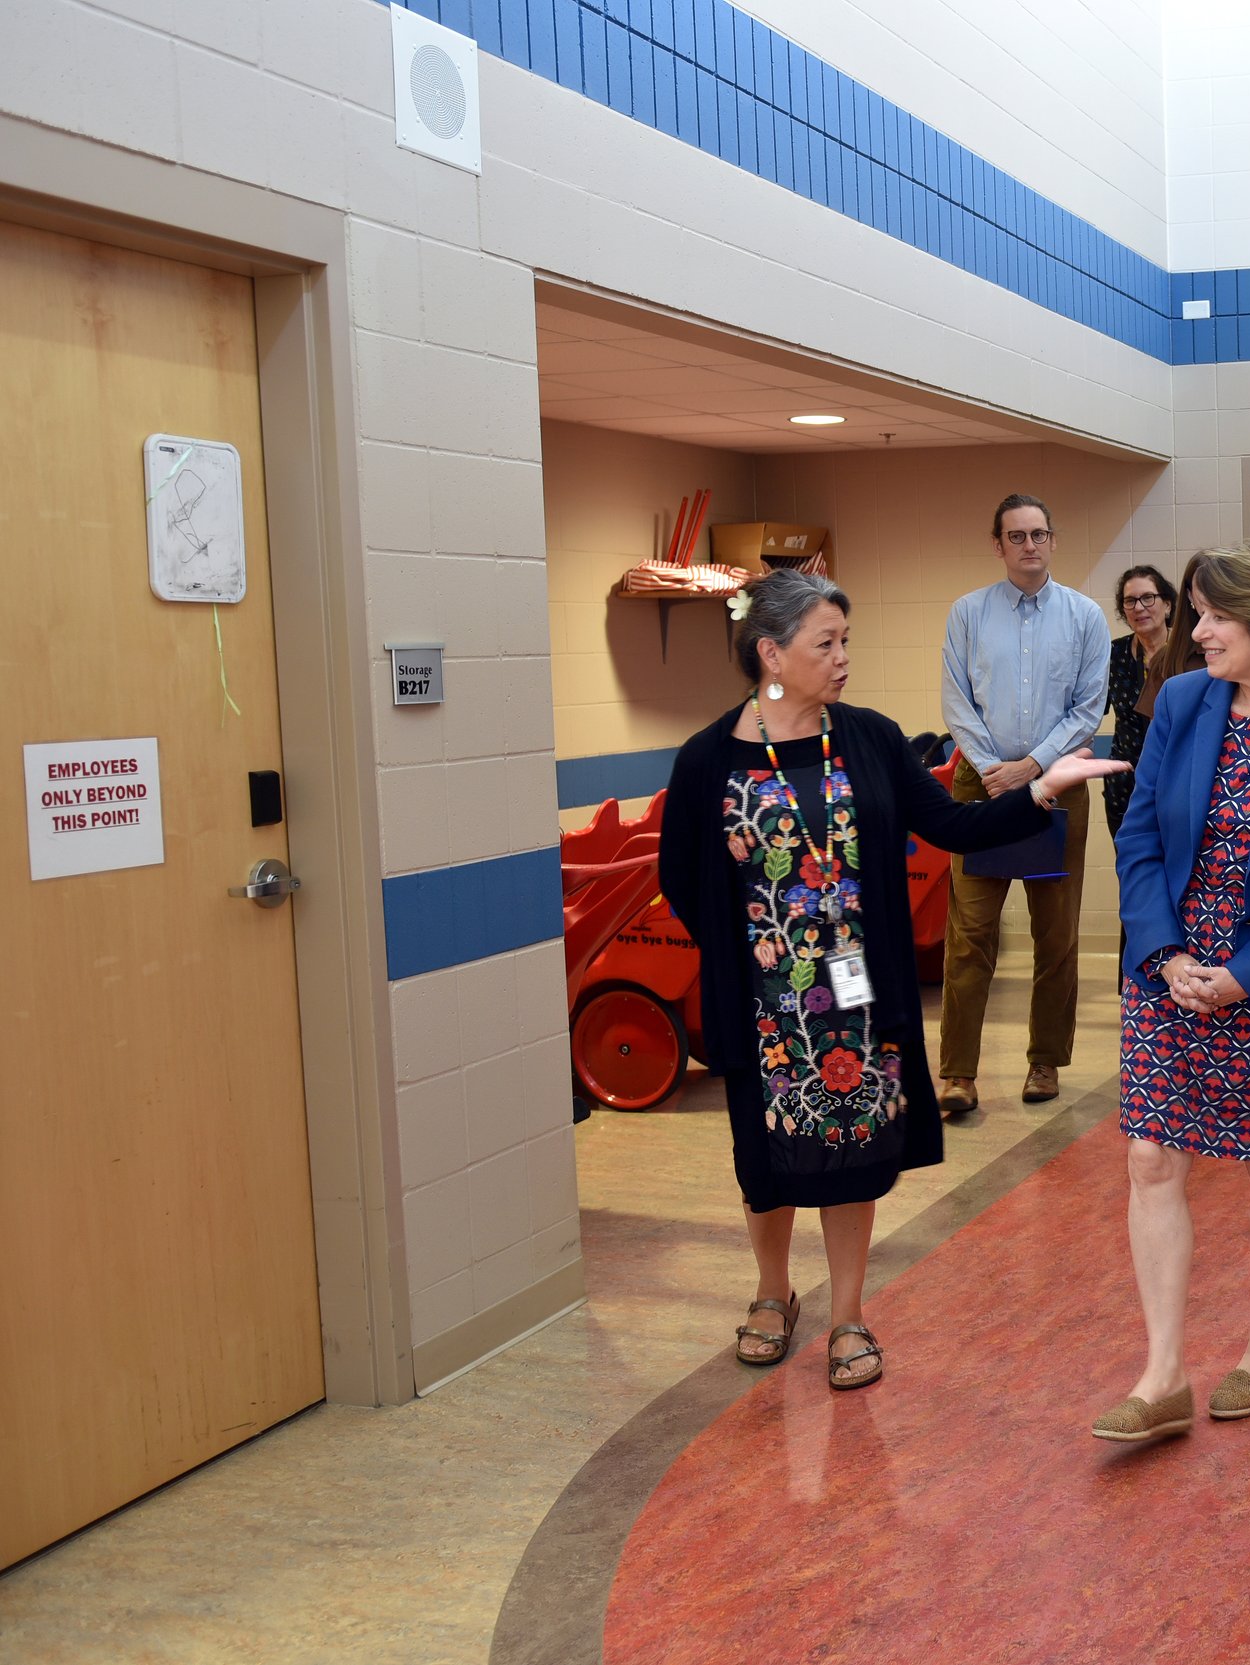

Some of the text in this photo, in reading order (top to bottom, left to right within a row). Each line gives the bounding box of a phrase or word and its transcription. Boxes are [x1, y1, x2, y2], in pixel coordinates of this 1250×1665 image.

[398, 665, 433, 678] Storage
[399, 680, 430, 695] B217
[48, 758, 138, 779] EMPLOYEES
[41, 784, 147, 806] ONLY BEYOND
[52, 809, 139, 831] THIS POINT!
[641, 933, 662, 946] bye
[666, 936, 696, 950] bugg
